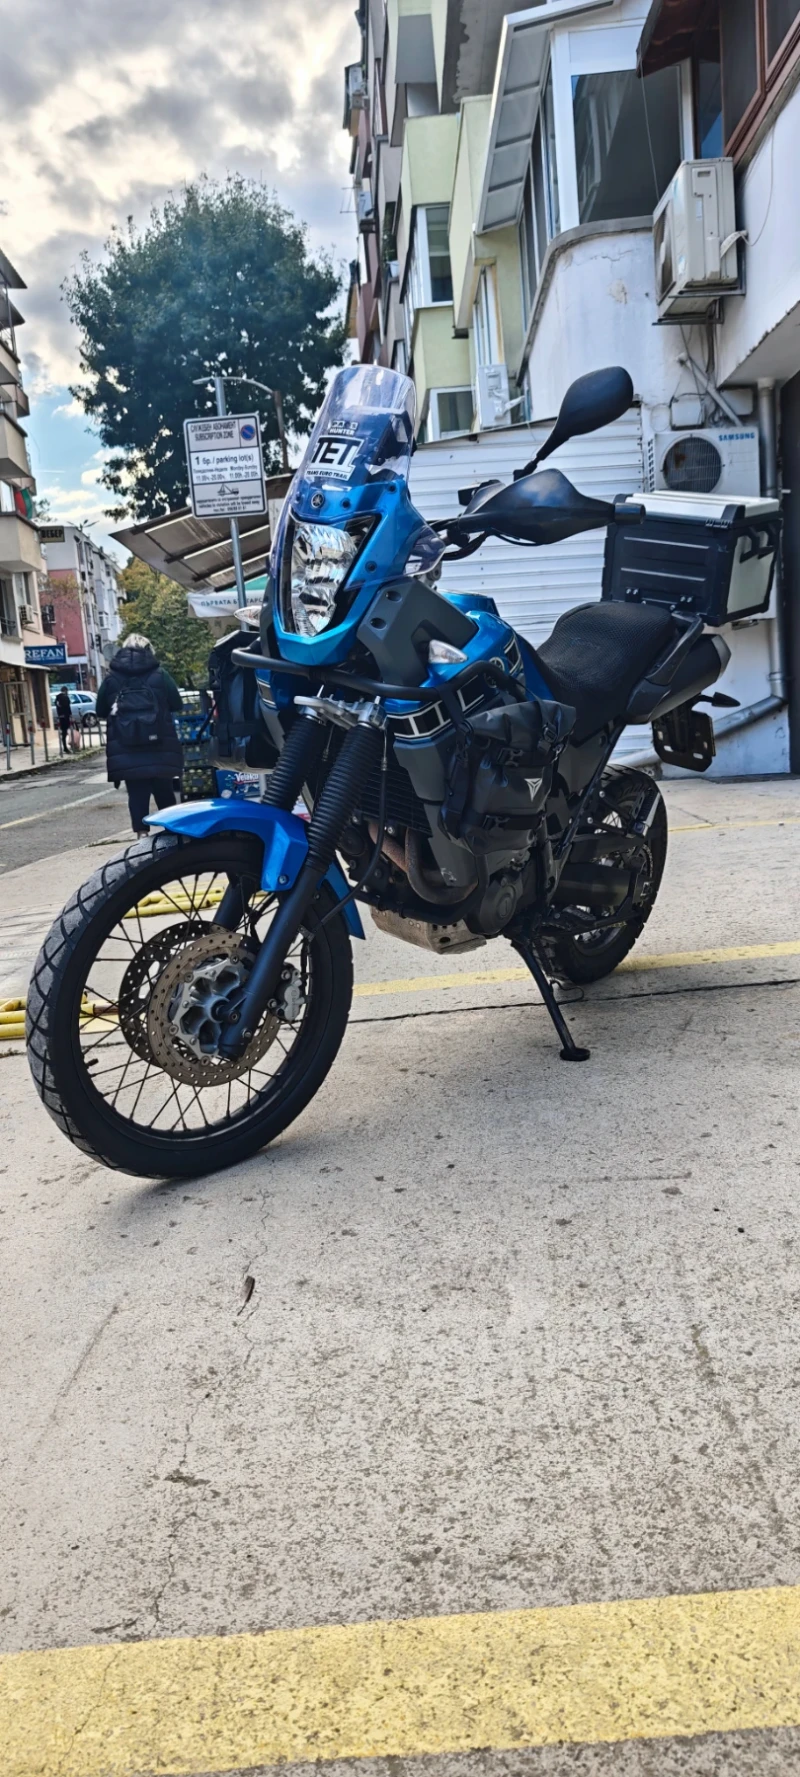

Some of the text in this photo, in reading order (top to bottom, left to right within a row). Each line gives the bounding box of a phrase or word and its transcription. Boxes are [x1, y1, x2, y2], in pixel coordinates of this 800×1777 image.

[213, 420, 236, 430] АБОНАМЕНТ
[195, 430, 234, 441] SUBSCRIPTION ZONE
[329, 428, 355, 436] HUNTER
[719, 432, 755, 441] SAMSUNG
[311, 437, 362, 466] TET
[195, 456, 200, 465] 1
[216, 455, 238, 465] parking
[238, 453, 254, 463] lot(s)
[333, 472, 348, 480] TRAIL
[200, 599, 231, 607] ПЪРВАТА
[25, 648, 64, 658] REFAN
